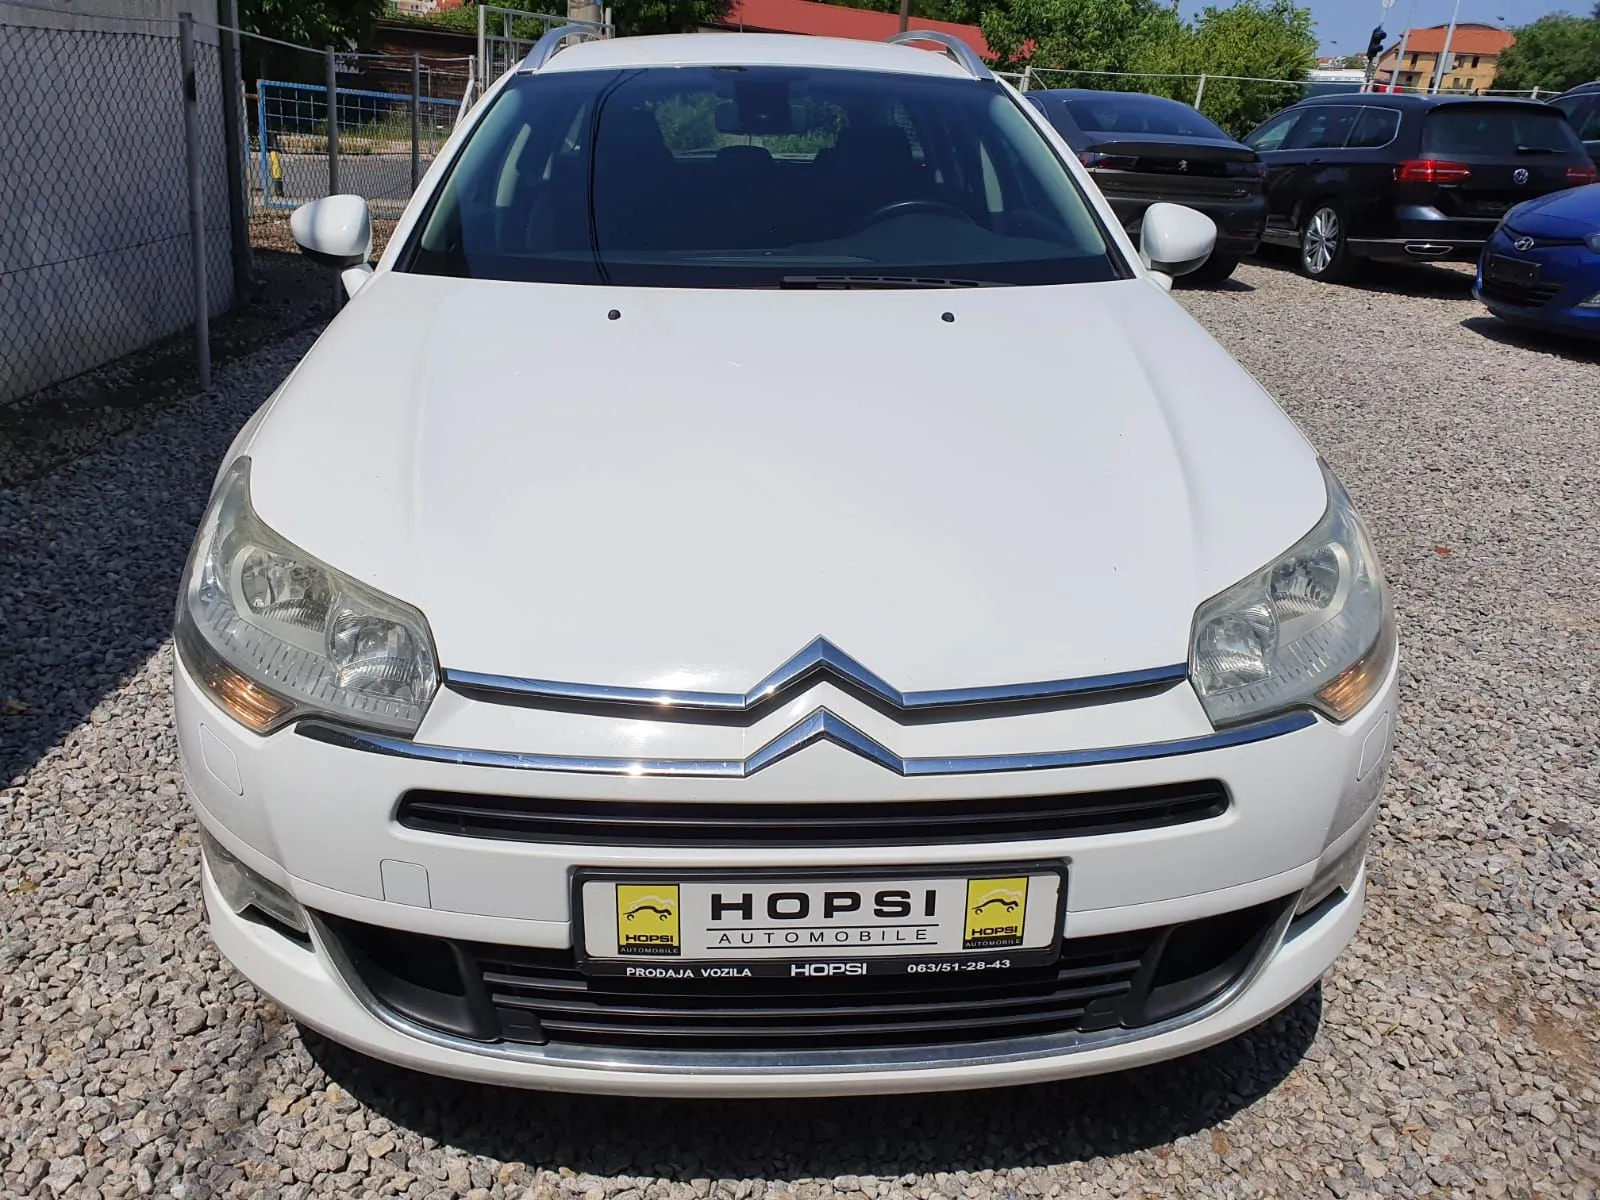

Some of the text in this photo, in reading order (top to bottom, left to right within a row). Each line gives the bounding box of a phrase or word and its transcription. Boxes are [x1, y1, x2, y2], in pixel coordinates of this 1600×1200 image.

[711, 890, 937, 920] HOPSI
[718, 929, 928, 944] AUTOMOBILE
[971, 925, 1018, 936] HOPSI
[625, 934, 674, 943] HOPSI
[965, 939, 1021, 947] AUTOMOBILE
[791, 962, 868, 977] HOPSI
[907, 959, 1011, 973] 063/51-28-43
[626, 967, 752, 978] PRODAJA VOZILA
